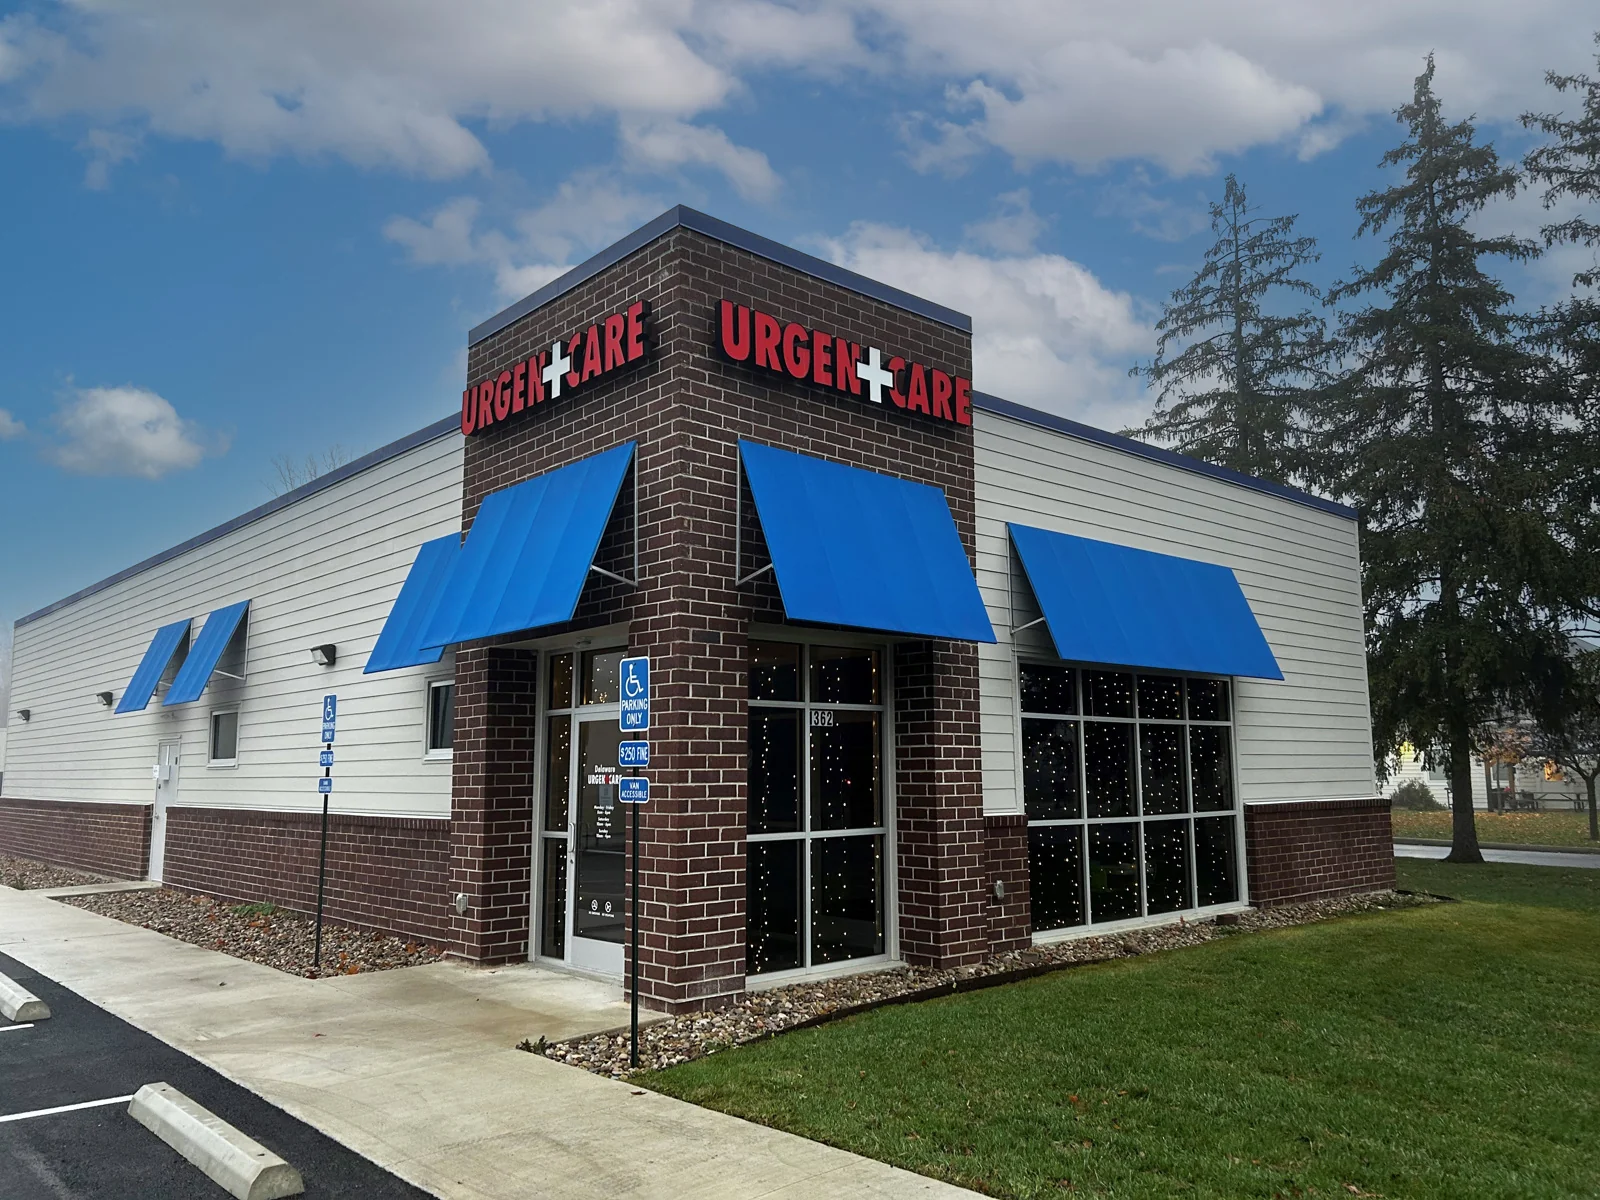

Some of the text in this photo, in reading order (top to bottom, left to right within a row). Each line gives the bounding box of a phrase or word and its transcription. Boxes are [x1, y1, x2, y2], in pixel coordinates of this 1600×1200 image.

[622, 698, 648, 711] PARKING
[627, 712, 643, 725] ONLY
[620, 746, 648, 761] $250 FINE
[594, 764, 616, 773] Delaware
[629, 782, 640, 790] VAN
[621, 790, 647, 799] ACCESSIBLE
